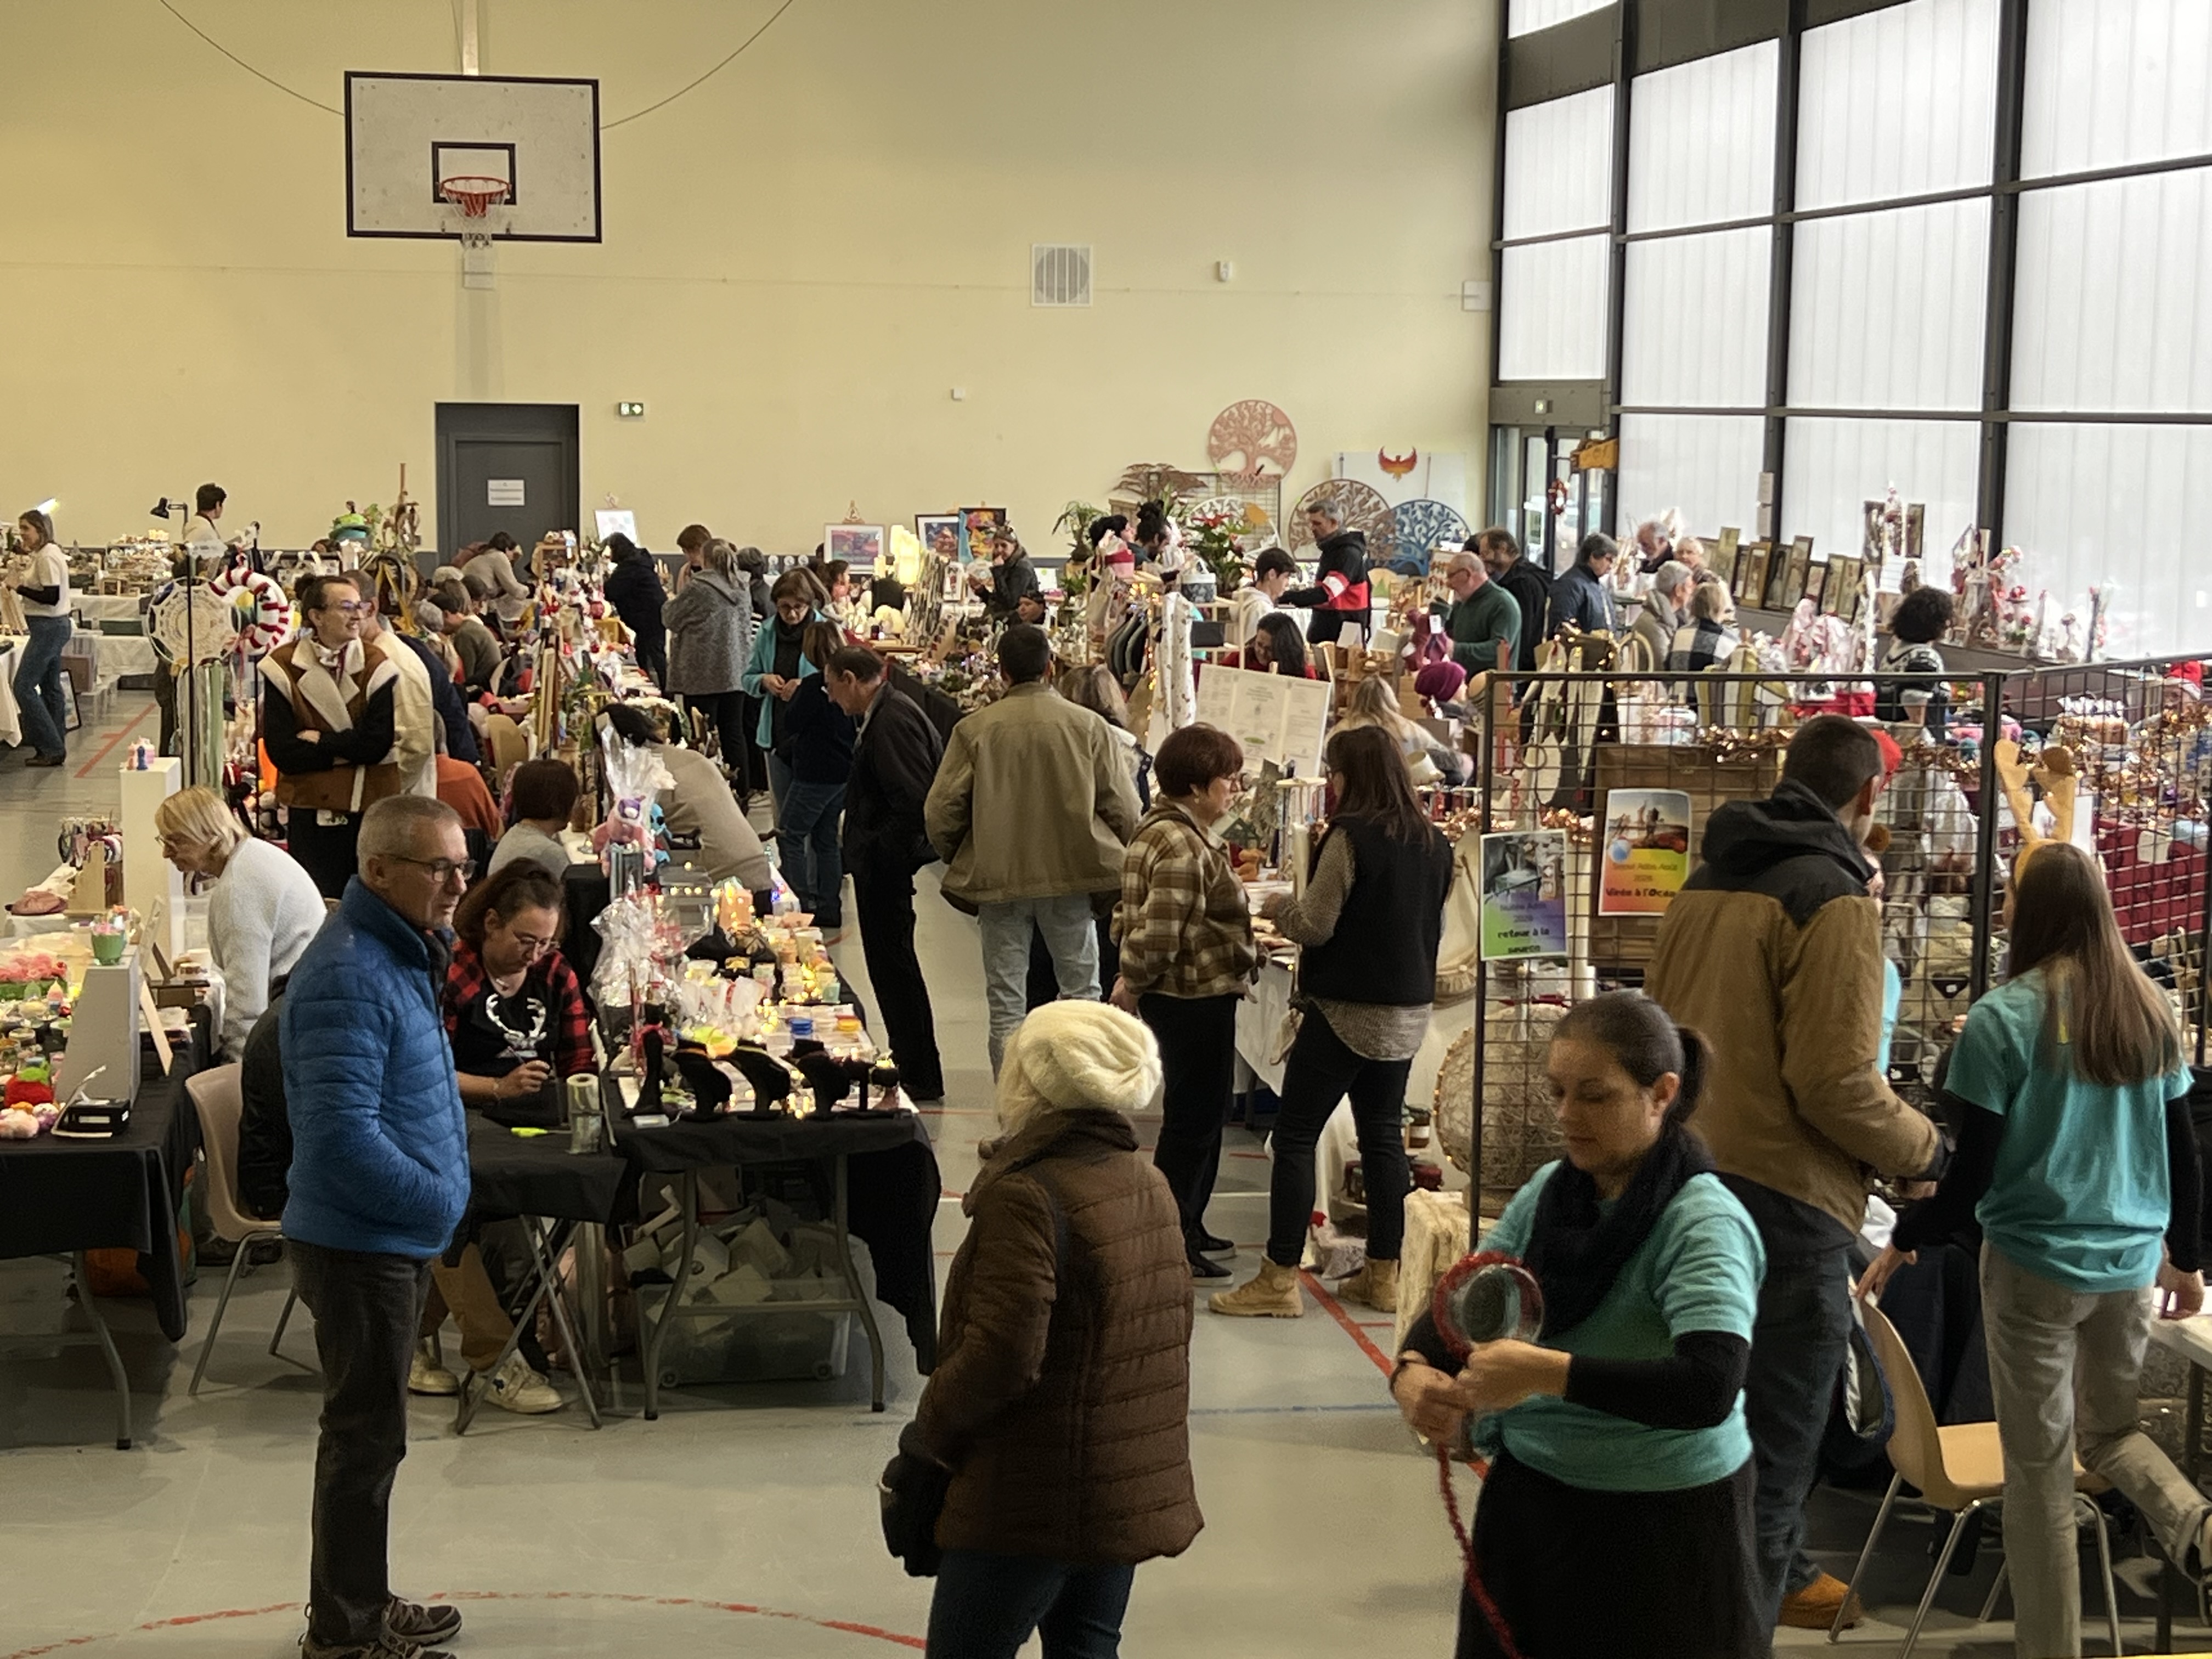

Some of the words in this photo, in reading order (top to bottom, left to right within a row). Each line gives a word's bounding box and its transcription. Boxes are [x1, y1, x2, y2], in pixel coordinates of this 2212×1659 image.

[1635, 888, 1641, 896] à
[1497, 929, 1530, 939] retour
[1532, 928, 1538, 936] à
[1540, 927, 1549, 935] la
